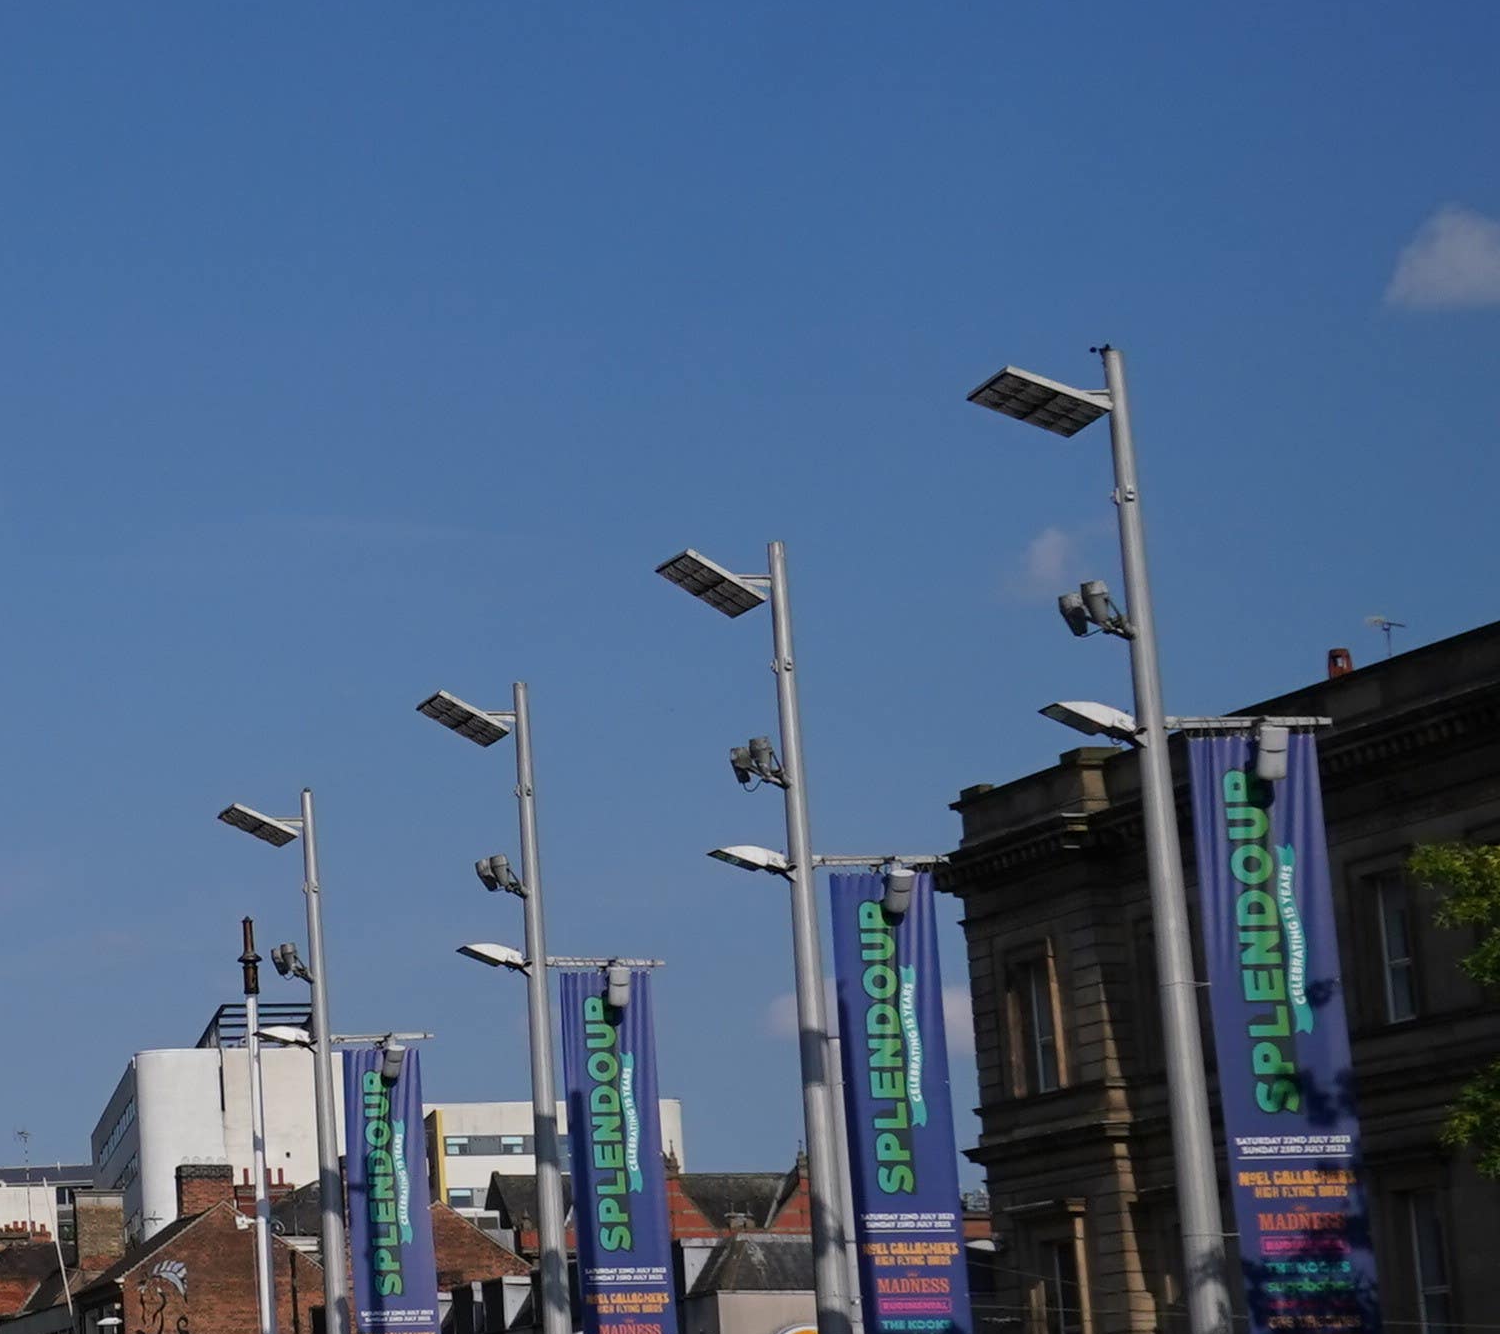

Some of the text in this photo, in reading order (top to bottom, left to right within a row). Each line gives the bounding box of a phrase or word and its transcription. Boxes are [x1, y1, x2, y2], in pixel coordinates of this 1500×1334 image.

[1279, 864, 1308, 1005] CELEBRATING 15 YEARS
[902, 982, 922, 1103] CELEBRATING 15 YEARS
[877, 1278, 950, 1294] MADNESS
